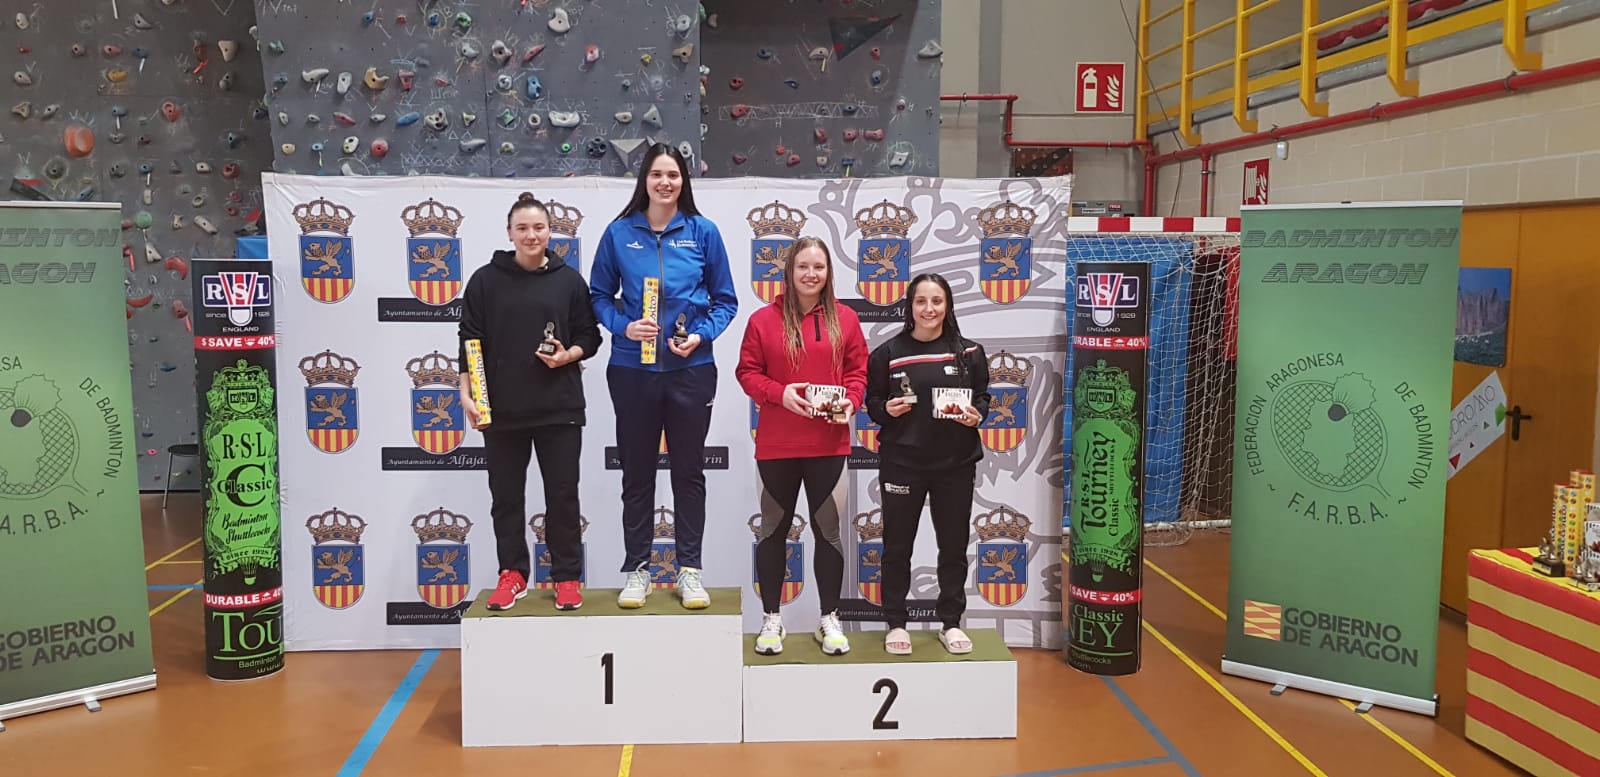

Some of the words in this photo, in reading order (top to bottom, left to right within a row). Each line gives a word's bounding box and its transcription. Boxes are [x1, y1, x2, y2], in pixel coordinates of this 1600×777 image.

[0, 228, 120, 247] INTON
[1241, 227, 1459, 249] BADMINTON
[1261, 262, 1429, 285] ARAGON
[208, 337, 242, 347] SAVE
[1126, 337, 1146, 347] 40%
[79, 377, 101, 398] DE
[95, 396, 123, 479] BADMINTON
[1244, 394, 1267, 476] FEDERACION
[1266, 352, 1344, 392] ARAGONESA
[1394, 381, 1417, 402] DE
[1407, 404, 1434, 490] BADMINTON
[447, 454, 487, 468] Alfaja
[217, 476, 272, 494] Classic
[1081, 431, 1116, 533] Tourney
[221, 511, 269, 530] Badminton
[1108, 498, 1119, 537] Classic
[206, 593, 260, 605] DURABLE
[1072, 586, 1097, 600] SAVE
[1112, 592, 1134, 602] 40%
[1074, 604, 1124, 622] Classic
[1284, 607, 1402, 643] GOBIERNO
[32, 631, 135, 667] ARAGON
[1283, 625, 1311, 647] DE
[1319, 633, 1419, 667] ARAGON
[238, 655, 277, 668] Badminton
[601, 652, 614, 705] 1
[872, 677, 899, 730] 2
